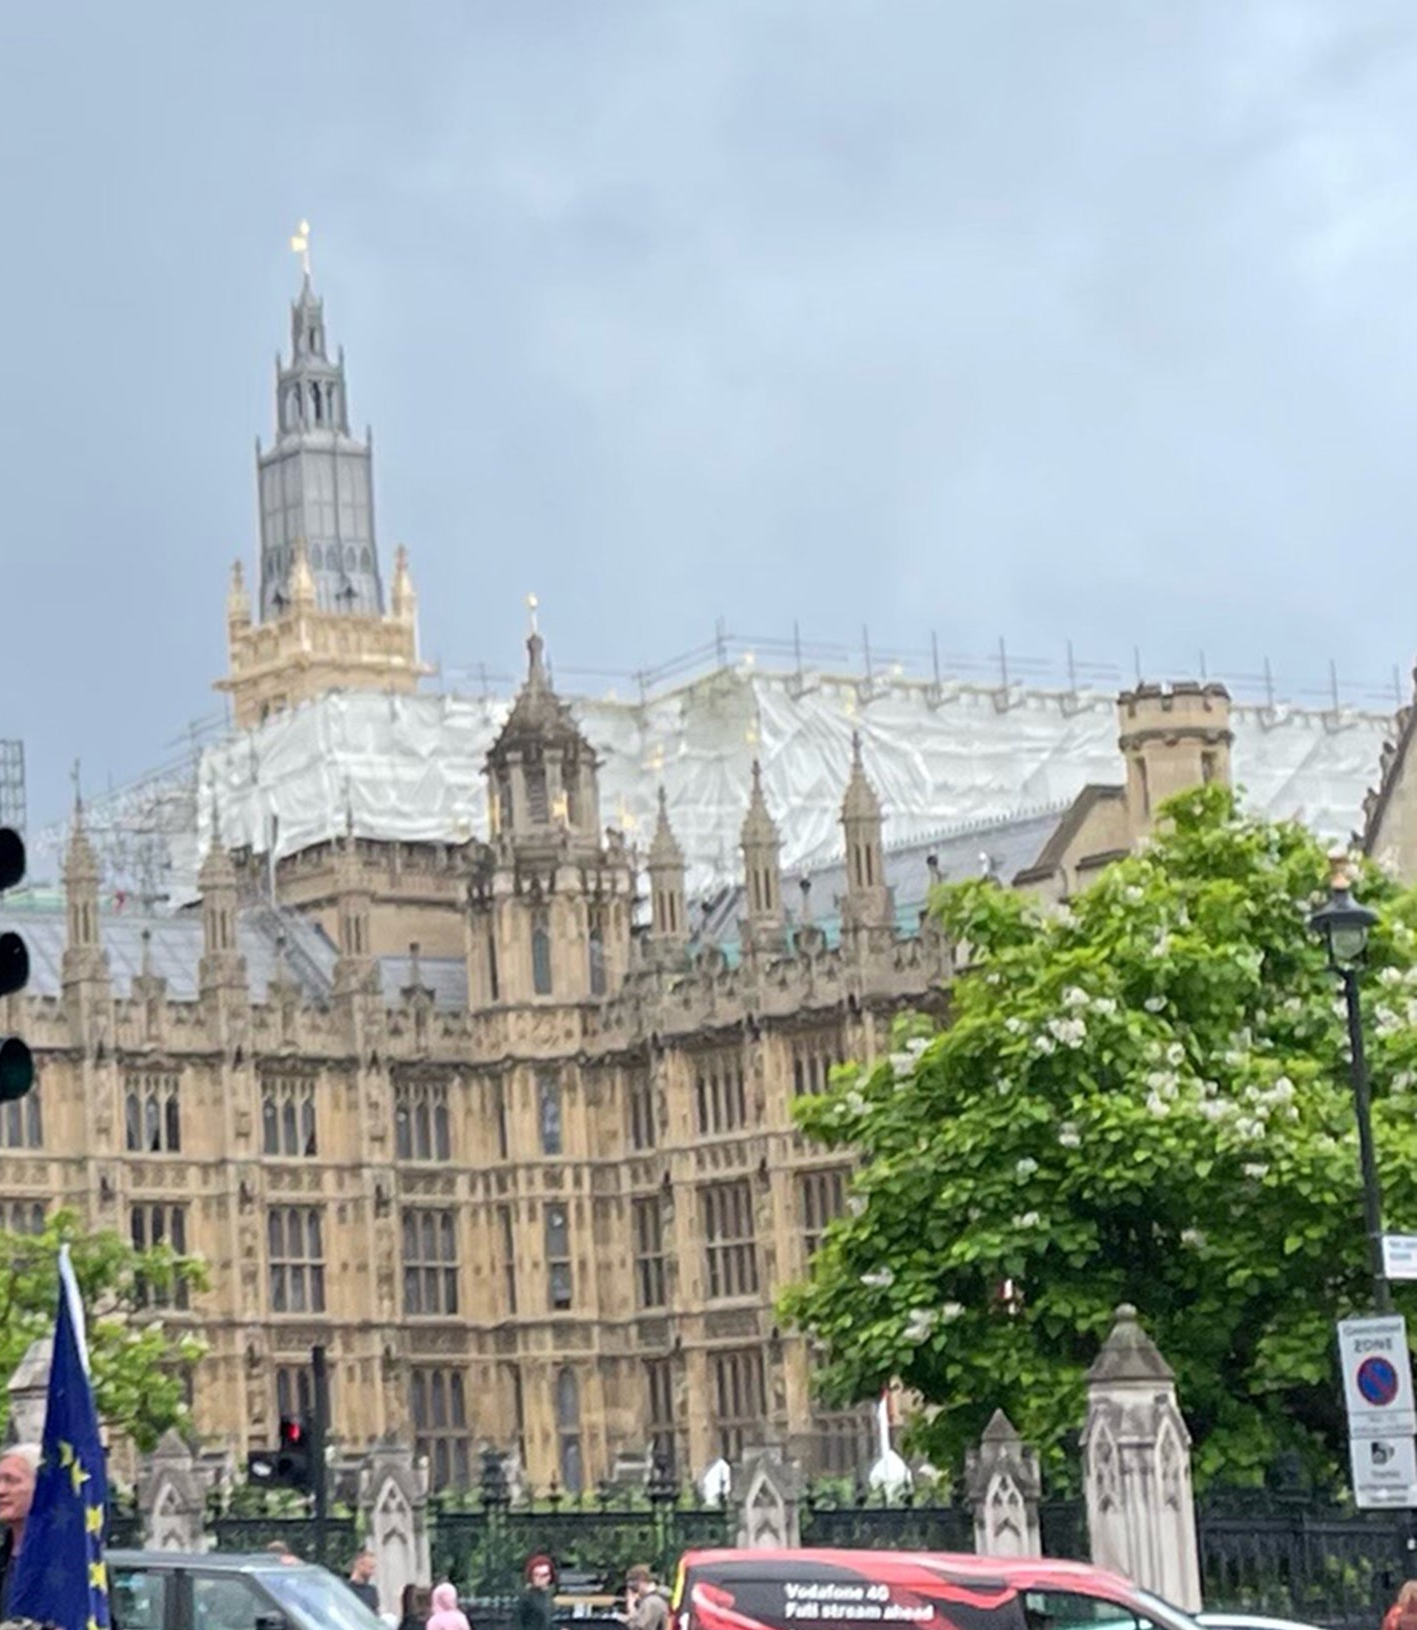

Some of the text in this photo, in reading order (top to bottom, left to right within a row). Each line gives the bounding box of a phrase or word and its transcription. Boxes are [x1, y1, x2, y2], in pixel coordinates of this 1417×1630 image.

[1354, 1338, 1393, 1352] ZONE
[785, 1583, 890, 1601] Vodafone 4G
[785, 1602, 934, 1621] Full stream ahead
